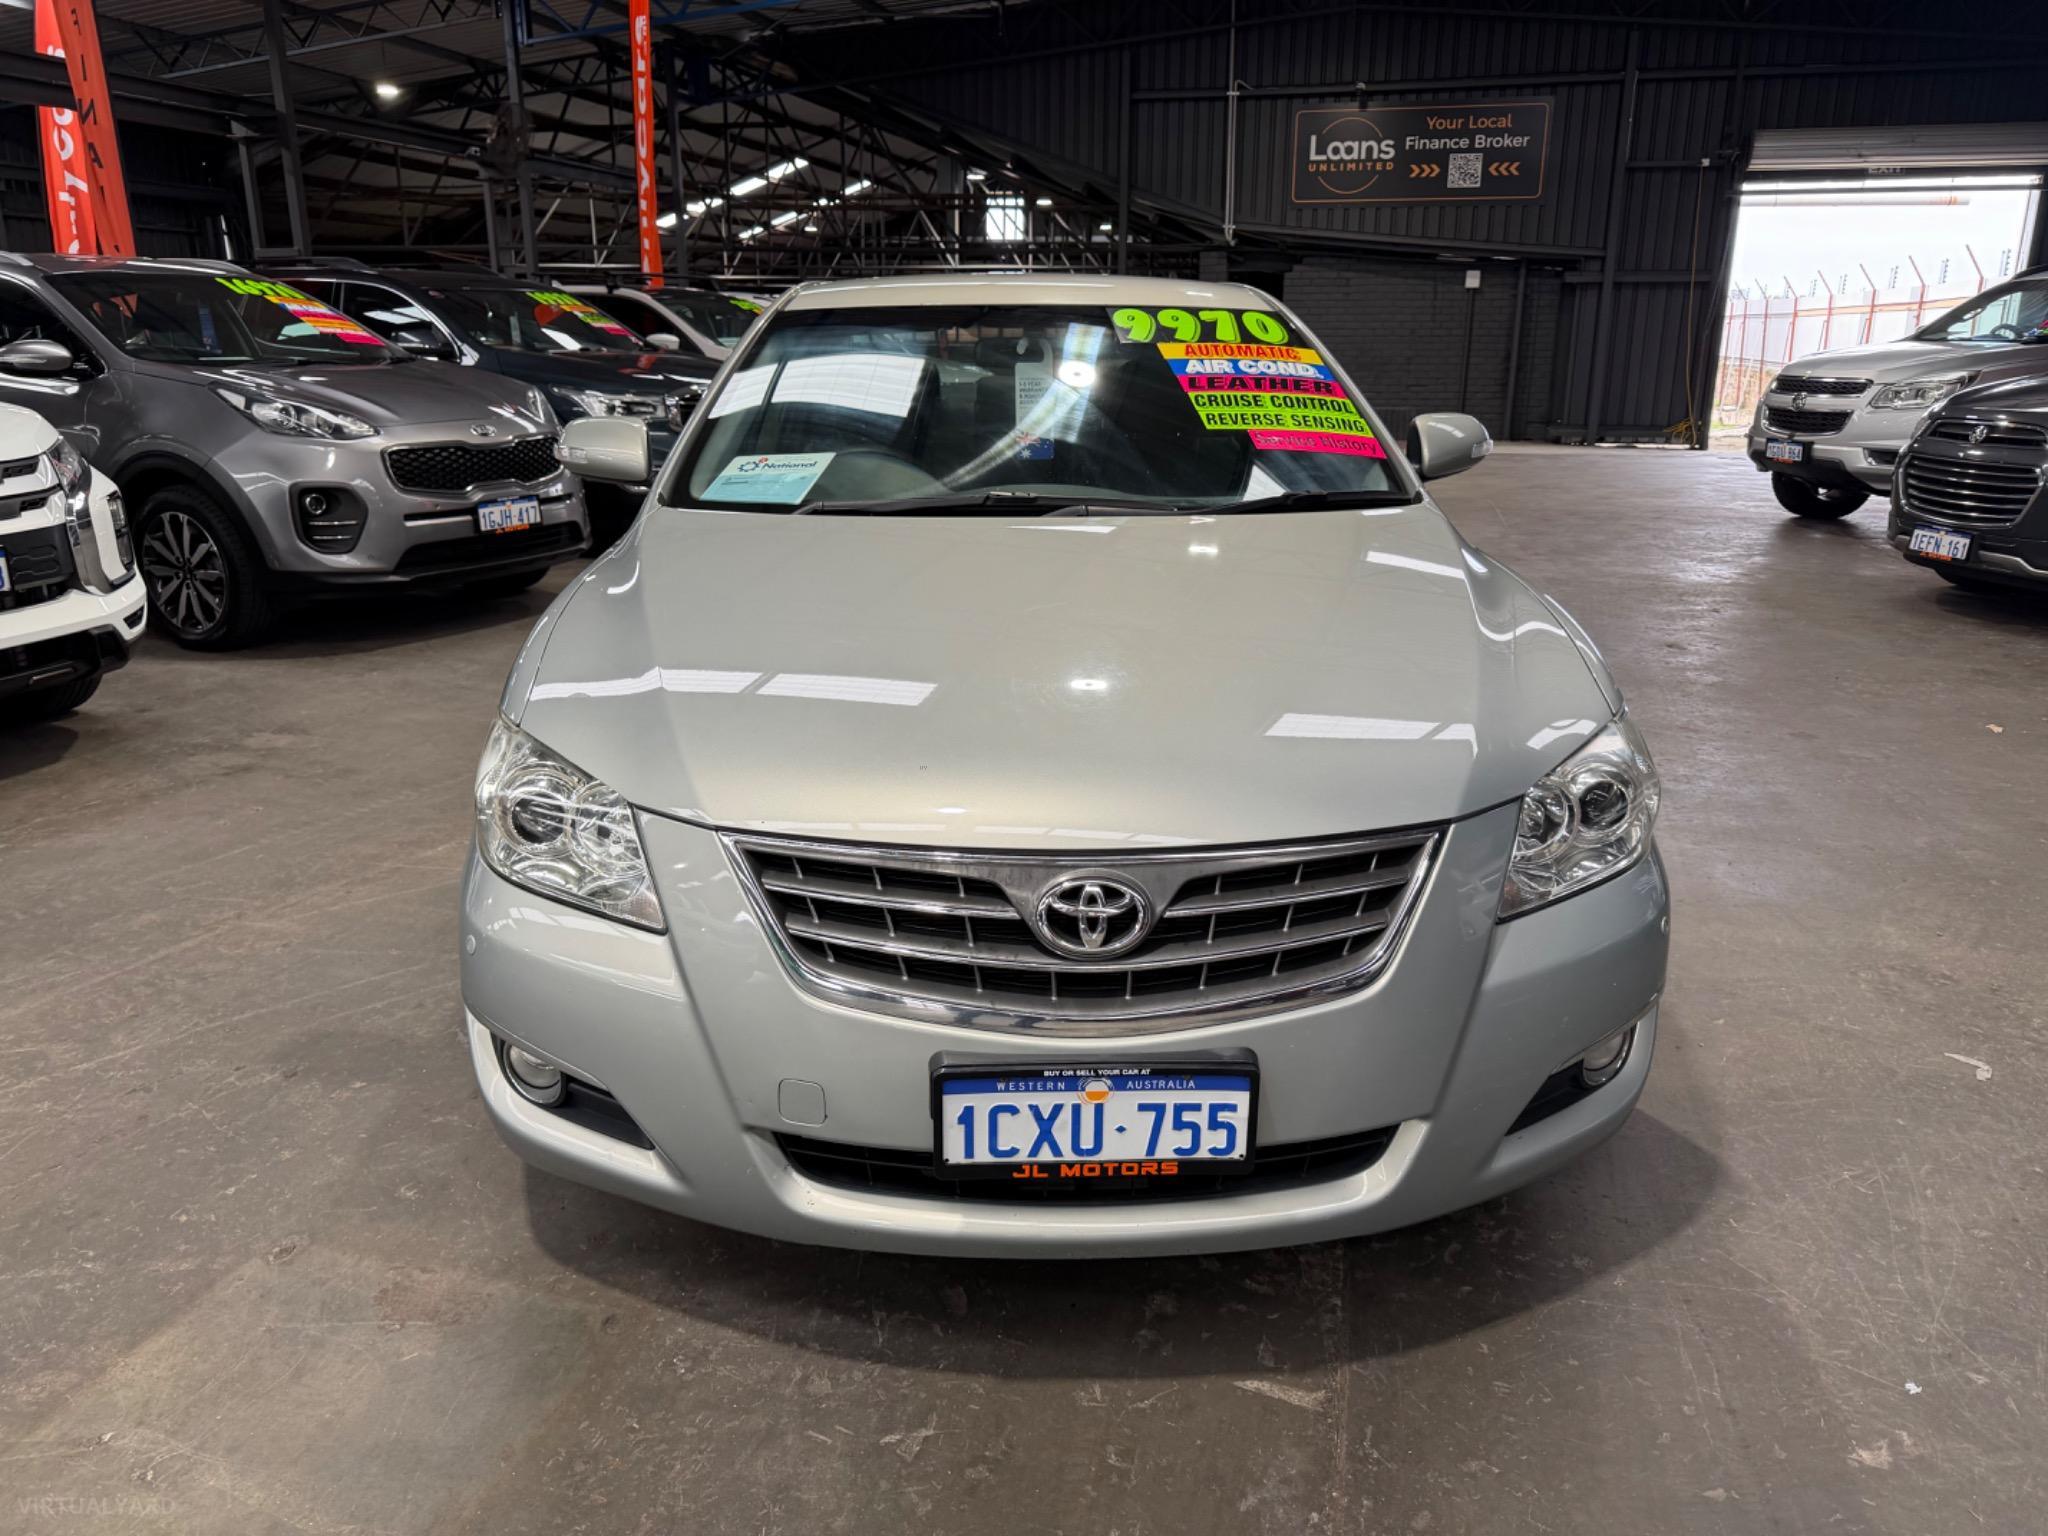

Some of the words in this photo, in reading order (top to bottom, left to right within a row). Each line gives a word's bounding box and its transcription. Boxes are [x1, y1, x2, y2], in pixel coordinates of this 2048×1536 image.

[1426, 115, 1464, 130] Your
[1469, 113, 1512, 129] Local
[1309, 135, 1396, 161] Loans
[1405, 136, 1470, 150] Finance
[1474, 134, 1530, 149] Broker
[1308, 162, 1394, 172] UNLIMITED
[1112, 308, 1289, 345] 9970
[1185, 359, 1235, 374] AIR
[1188, 376, 1333, 394] LEATHER
[1194, 393, 1264, 407] CRUISE
[1271, 395, 1353, 414] CONTROL
[1206, 412, 1285, 427] REVERSE
[1291, 414, 1365, 433] SENSING
[1255, 431, 1317, 448] Service
[1319, 435, 1377, 455] History
[762, 461, 818, 470] National
[996, 1081, 1065, 1091] WESTERN
[1126, 1079, 1196, 1090] AUSTRALIA
[1012, 1163, 1048, 1179] JL
[1060, 1161, 1178, 1177] MOTORS
